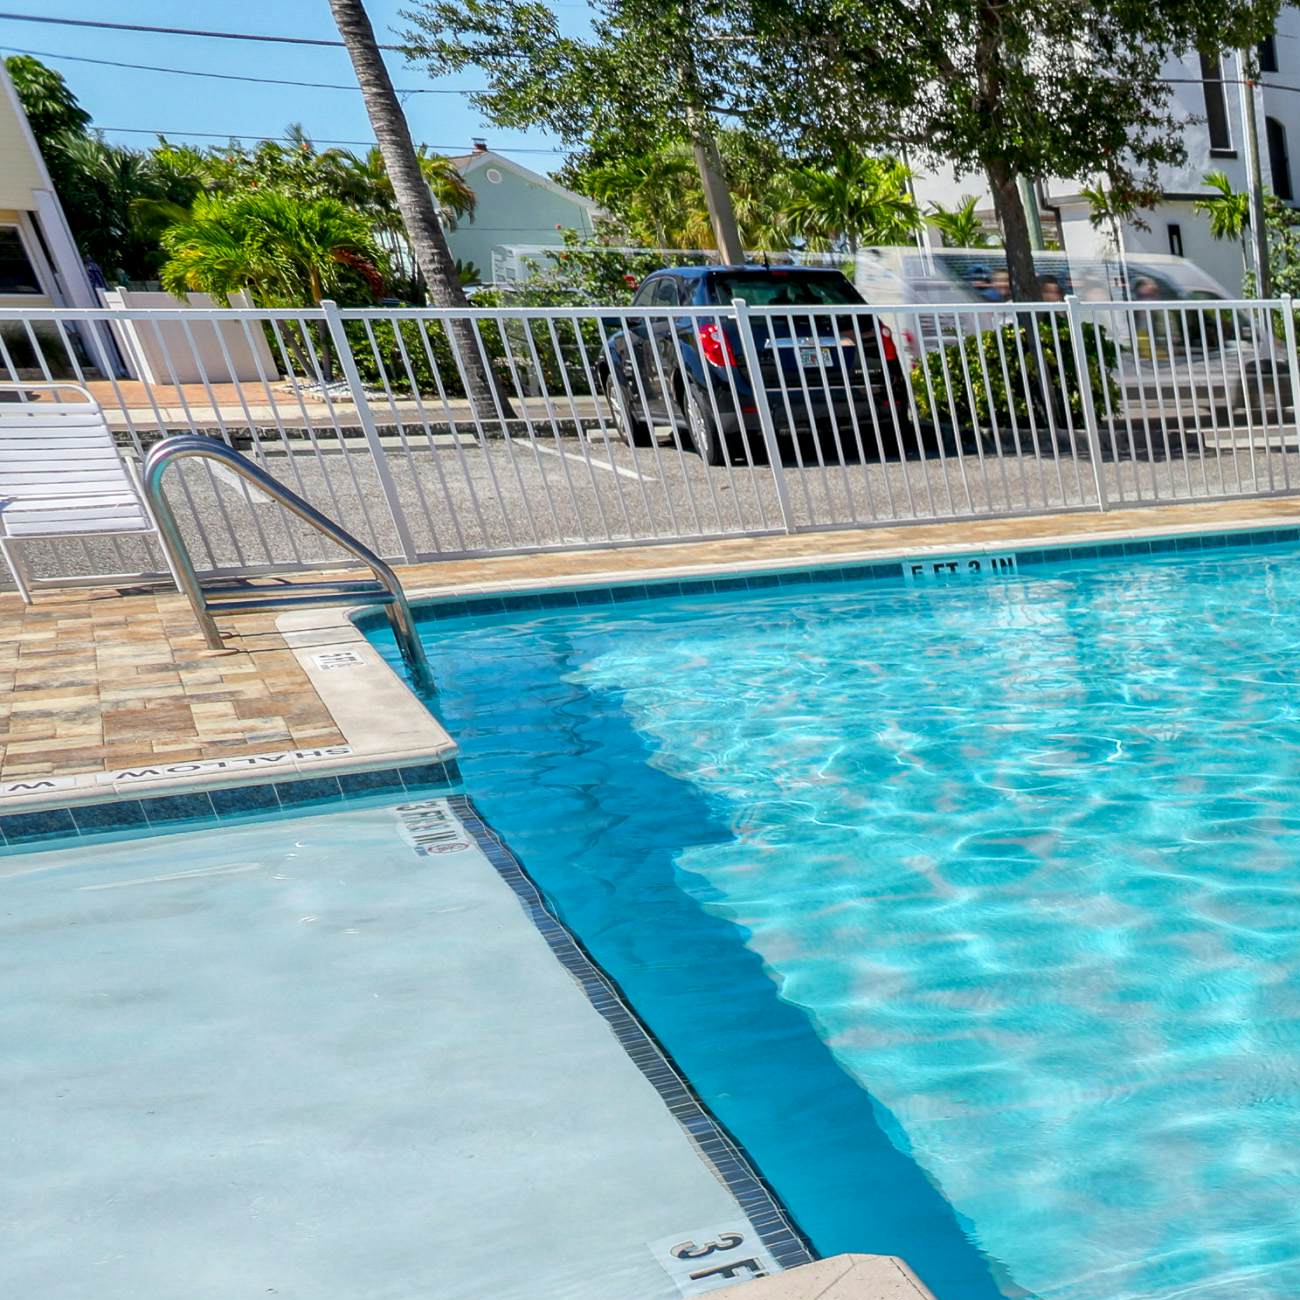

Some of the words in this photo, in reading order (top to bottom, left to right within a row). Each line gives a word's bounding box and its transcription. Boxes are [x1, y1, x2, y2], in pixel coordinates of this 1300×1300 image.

[991, 557, 1014, 576] IN
[116, 748, 350, 780] SHALLOW
[670, 1231, 745, 1259] 3
